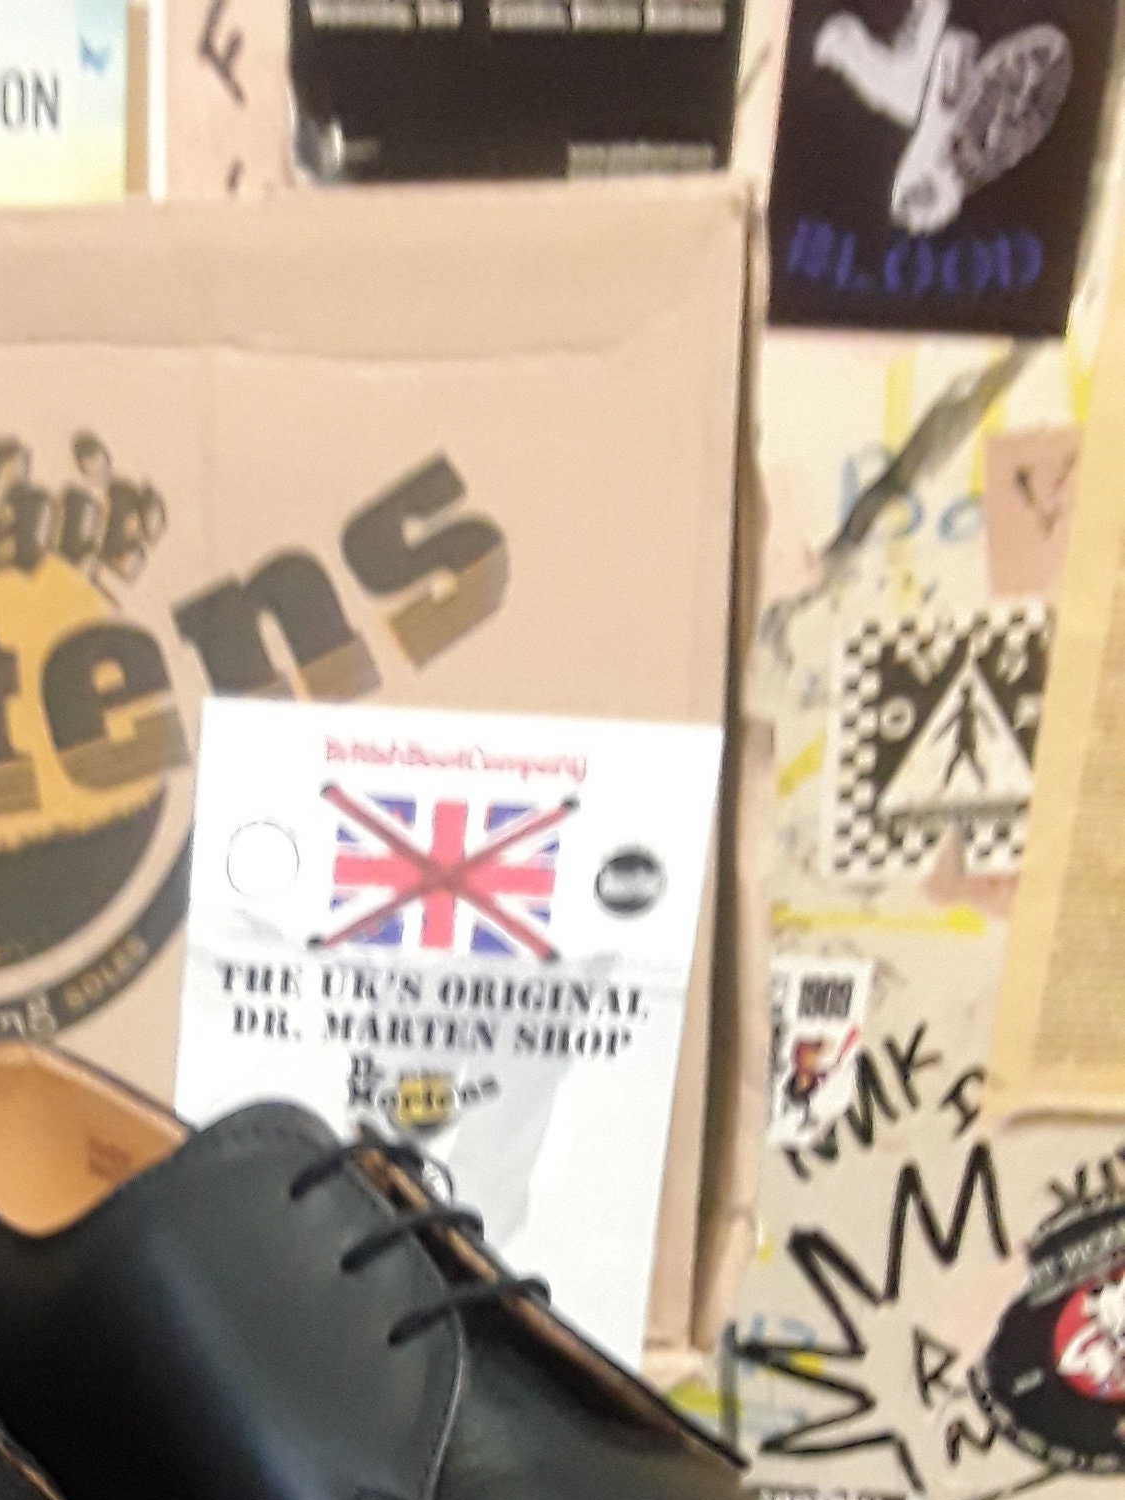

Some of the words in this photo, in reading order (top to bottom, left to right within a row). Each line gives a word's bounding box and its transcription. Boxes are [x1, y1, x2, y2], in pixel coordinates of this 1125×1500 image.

[219, 964, 302, 997] THE
[321, 967, 423, 1003] UK'S
[438, 974, 648, 1020] ORIGINAL
[231, 1006, 302, 1043] DR.
[323, 1008, 494, 1051] MARTEN
[514, 1022, 633, 1060] SHOP
